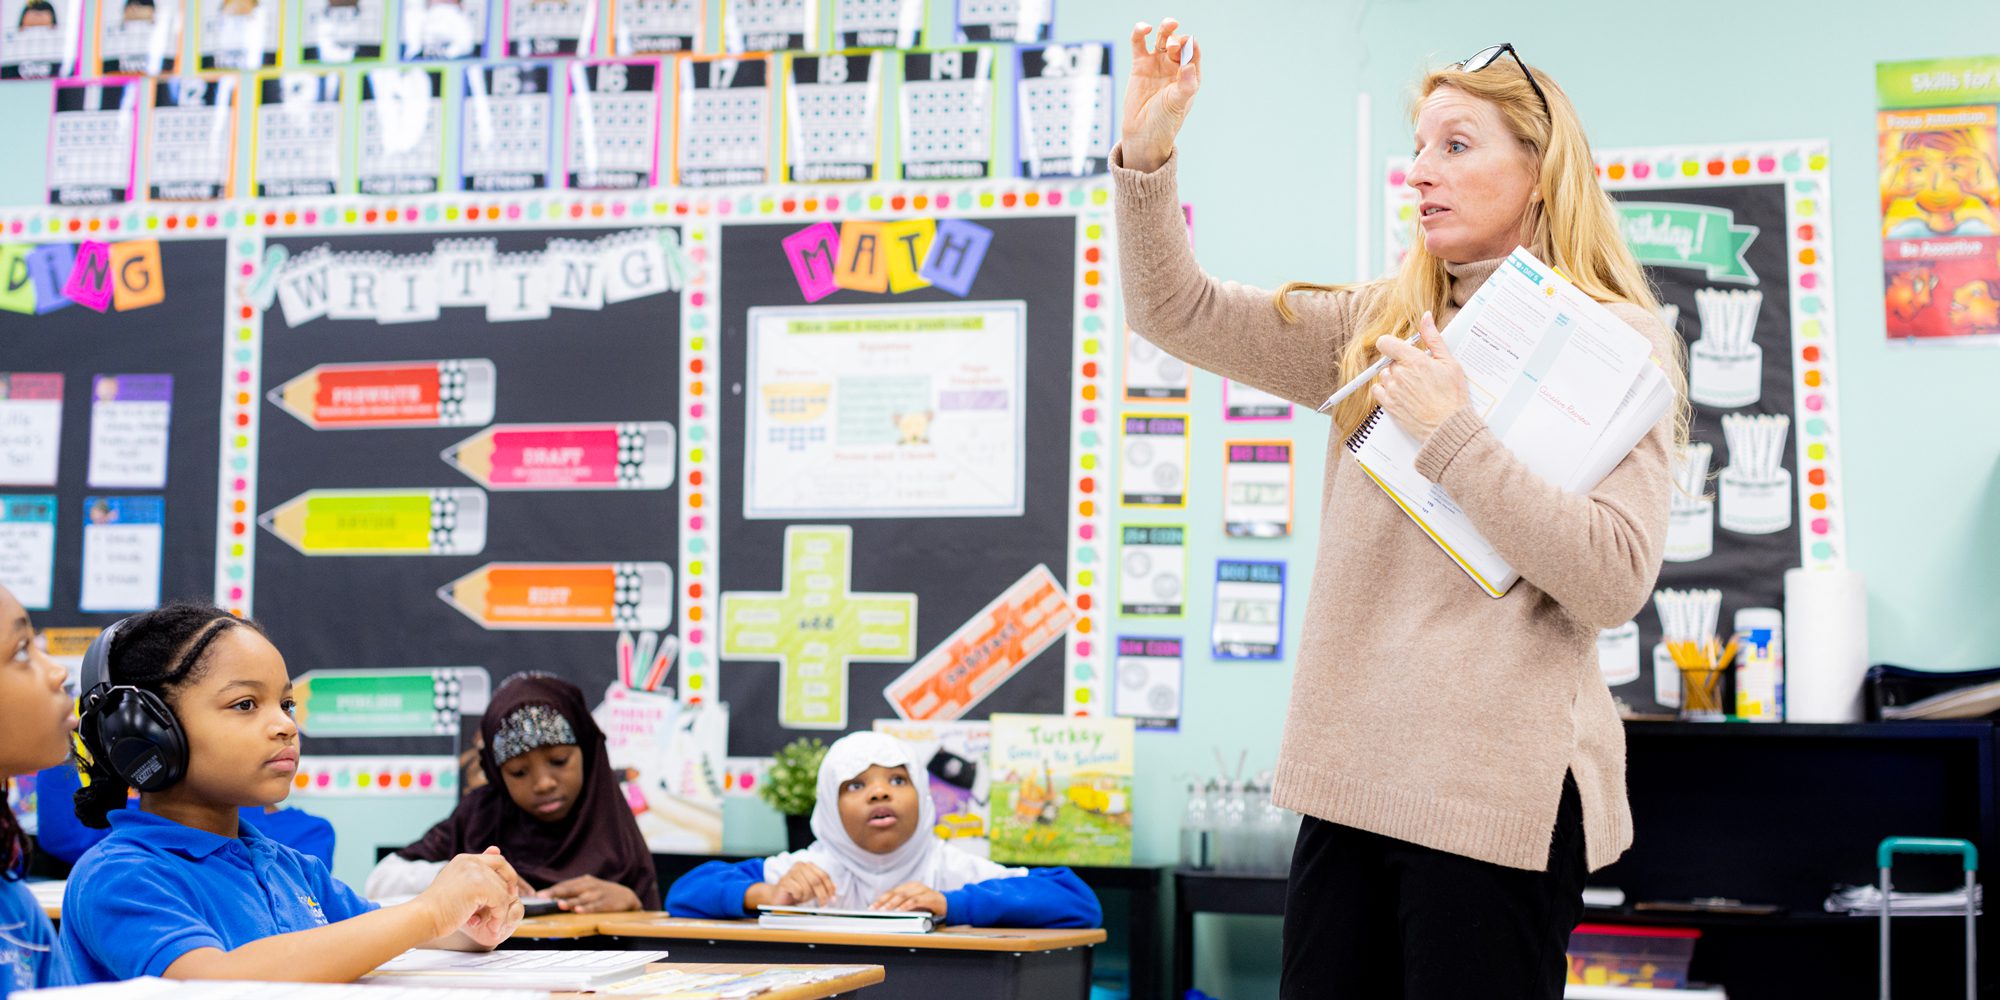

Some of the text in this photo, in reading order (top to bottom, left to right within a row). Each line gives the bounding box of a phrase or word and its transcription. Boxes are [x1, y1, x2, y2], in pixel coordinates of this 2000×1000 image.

[597, 65, 628, 91] 16
[709, 60, 739, 88] 17
[818, 56, 848, 83] 18
[930, 52, 962, 79] 19
[1912, 73, 1960, 93] Skills
[802, 232, 972, 281] MATH
[290, 248, 652, 311] WRITING
[522, 446, 584, 467] DRAFT
[528, 586, 571, 606] EDIT
[799, 613, 835, 632] add
[1027, 724, 1104, 752] Turkey
